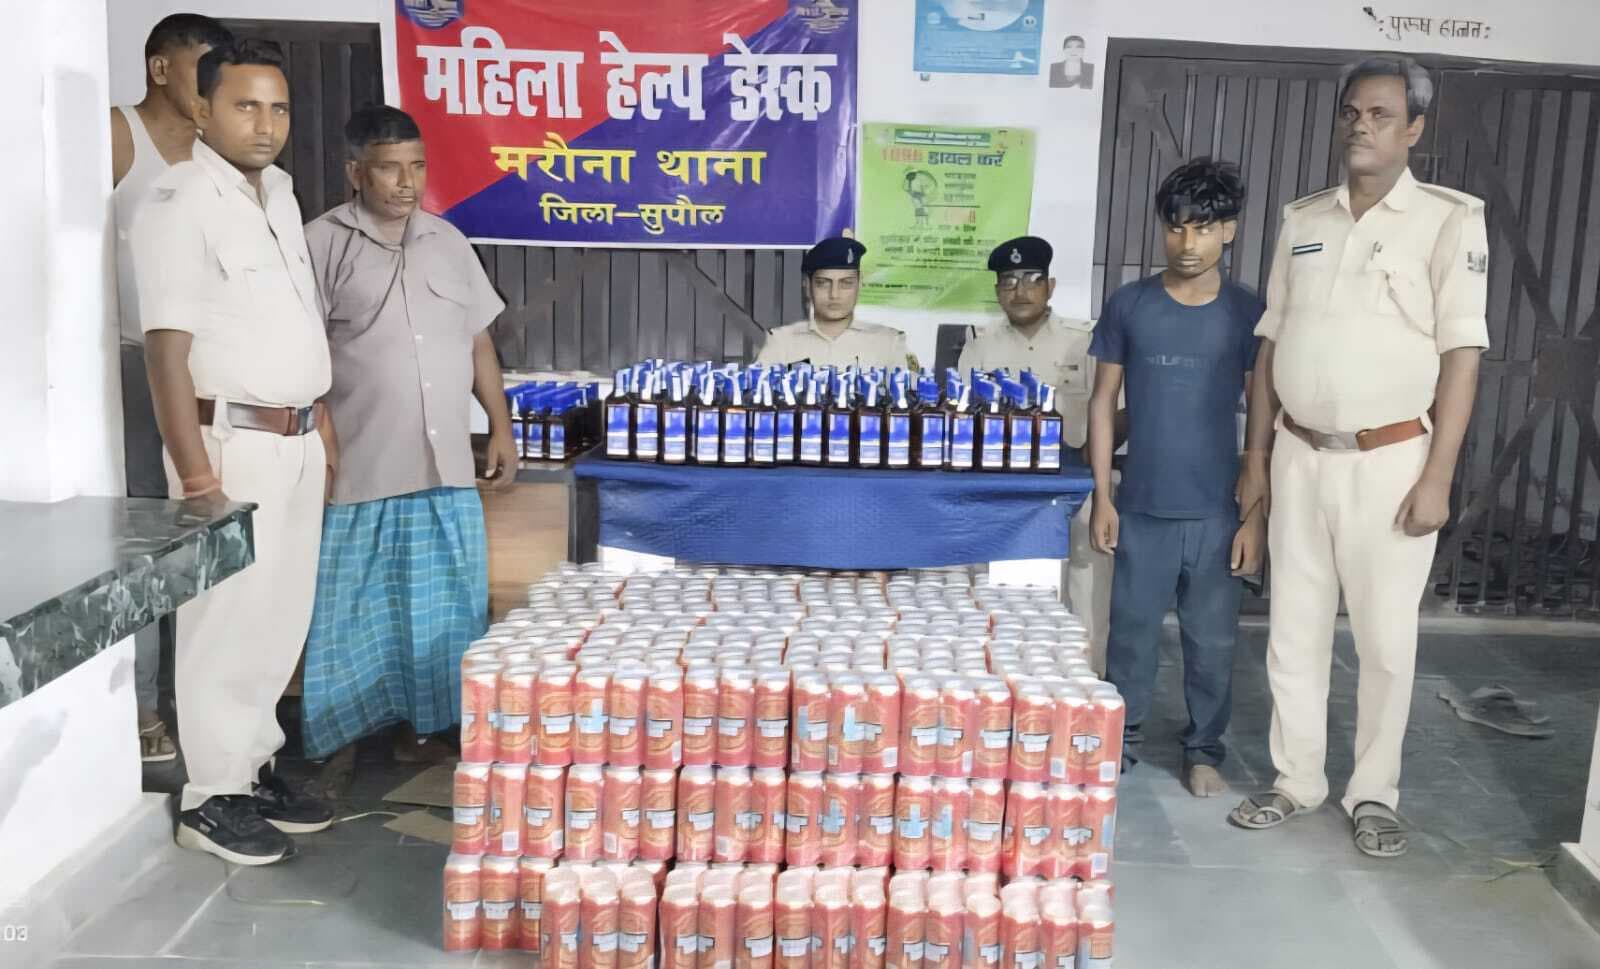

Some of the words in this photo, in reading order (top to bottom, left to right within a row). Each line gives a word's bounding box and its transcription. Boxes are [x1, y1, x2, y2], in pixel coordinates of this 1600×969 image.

[417, 26, 584, 119] महिला
[600, 31, 708, 121] हेल्प
[723, 33, 837, 122] डेस्क
[490, 132, 636, 184] मरौना
[656, 150, 767, 185] थाना
